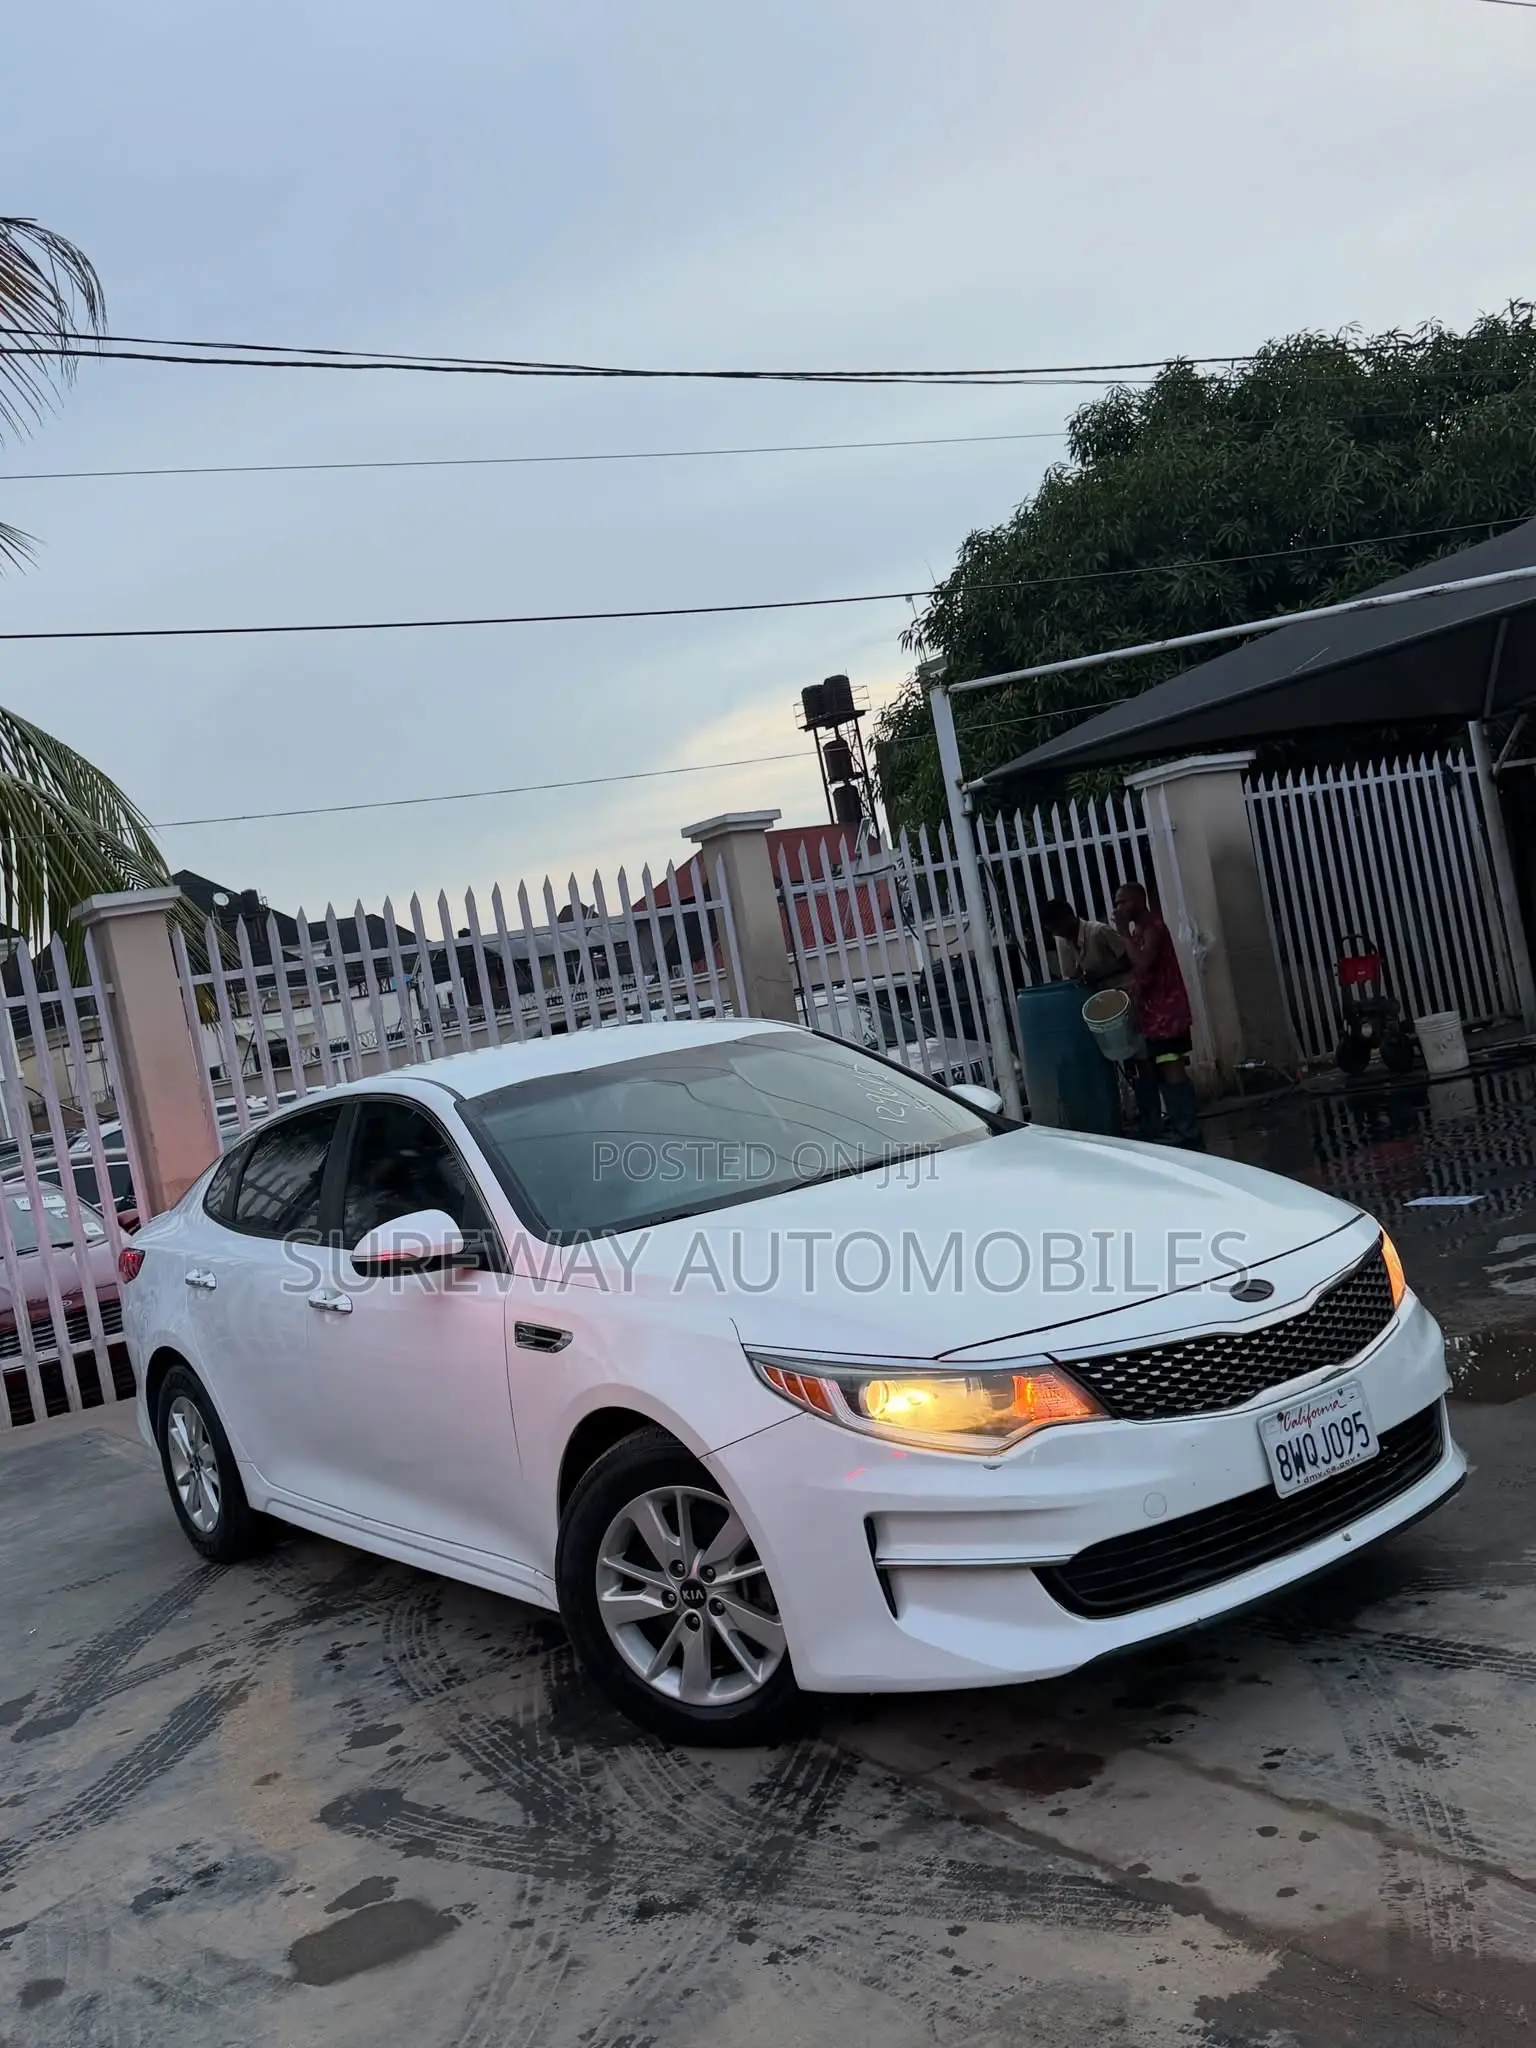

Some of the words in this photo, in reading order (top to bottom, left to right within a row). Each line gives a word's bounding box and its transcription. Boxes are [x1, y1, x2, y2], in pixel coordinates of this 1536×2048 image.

[1281, 1397, 1347, 1432] California
[1275, 1410, 1370, 1482] 8WQJ095
[1303, 1456, 1356, 1484] dmv.ca.gov
[682, 1589, 704, 1601] KIA
